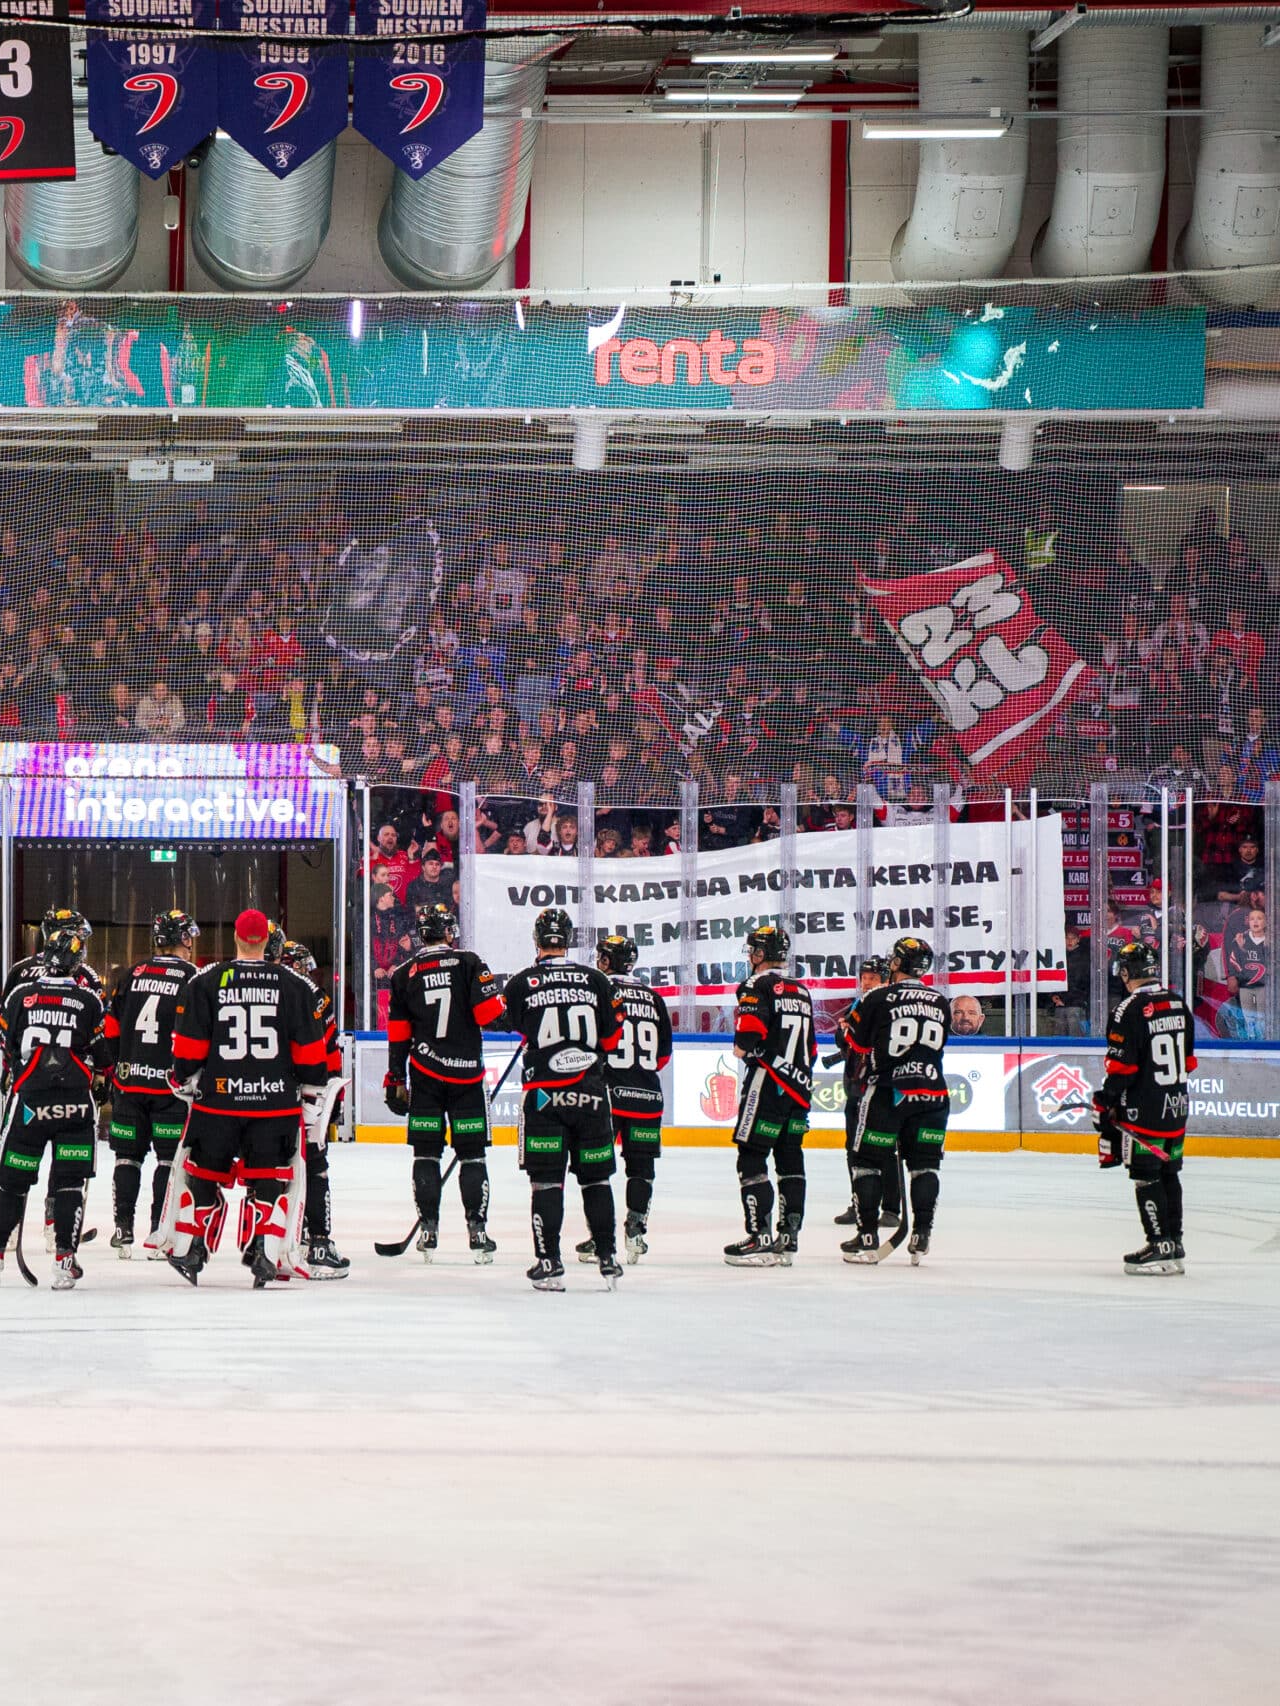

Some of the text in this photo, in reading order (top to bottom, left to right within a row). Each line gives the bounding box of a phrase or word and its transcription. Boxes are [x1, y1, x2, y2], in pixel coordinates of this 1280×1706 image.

[126, 43, 176, 65] 1997
[392, 43, 445, 65] 2016
[593, 331, 776, 385] renta
[64, 757, 184, 778] arena
[65, 788, 307, 823] interactive.
[1118, 813, 1131, 828] 5
[508, 885, 582, 906] VOIT
[870, 861, 999, 888] KERTAA
[1130, 871, 1144, 885] 4
[423, 972, 452, 989] TRUE
[542, 971, 589, 984] MELTEX
[218, 987, 280, 1004] SALMINEN
[620, 988, 655, 1004] MELTEX
[898, 990, 940, 1002] TNNet
[28, 1009, 78, 1030] HUOVILA
[135, 994, 161, 1044] 4
[424, 987, 452, 1039] 7
[889, 1002, 945, 1023] TYRVÄINEN
[218, 1005, 279, 1060] 35
[537, 1004, 598, 1050] 40
[608, 1019, 659, 1071] 39
[1150, 1032, 1188, 1087] 91
[129, 1063, 170, 1079] Hidpe
[892, 1061, 924, 1078] FINSE
[228, 1076, 285, 1094] Market
[552, 1091, 603, 1111] KSPT
[36, 1103, 89, 1121] KSPT
[155, 1124, 182, 1135] fennia
[411, 1118, 439, 1129] fennia
[456, 1119, 484, 1131] fennia
[633, 1129, 658, 1140] fennia
[59, 1147, 89, 1158] fennia
[530, 1139, 560, 1149] fennia
[8, 1154, 38, 1168] fennia
[584, 1148, 612, 1162] fennia
[745, 1194, 758, 1232] GRAM
[1144, 1200, 1161, 1236] GRAM
[758, 1233, 771, 1246] 10
[860, 1233, 873, 1247] 10
[1157, 1241, 1170, 1255] 10
[313, 1247, 326, 1260] 10
[61, 1257, 72, 1270] 10
